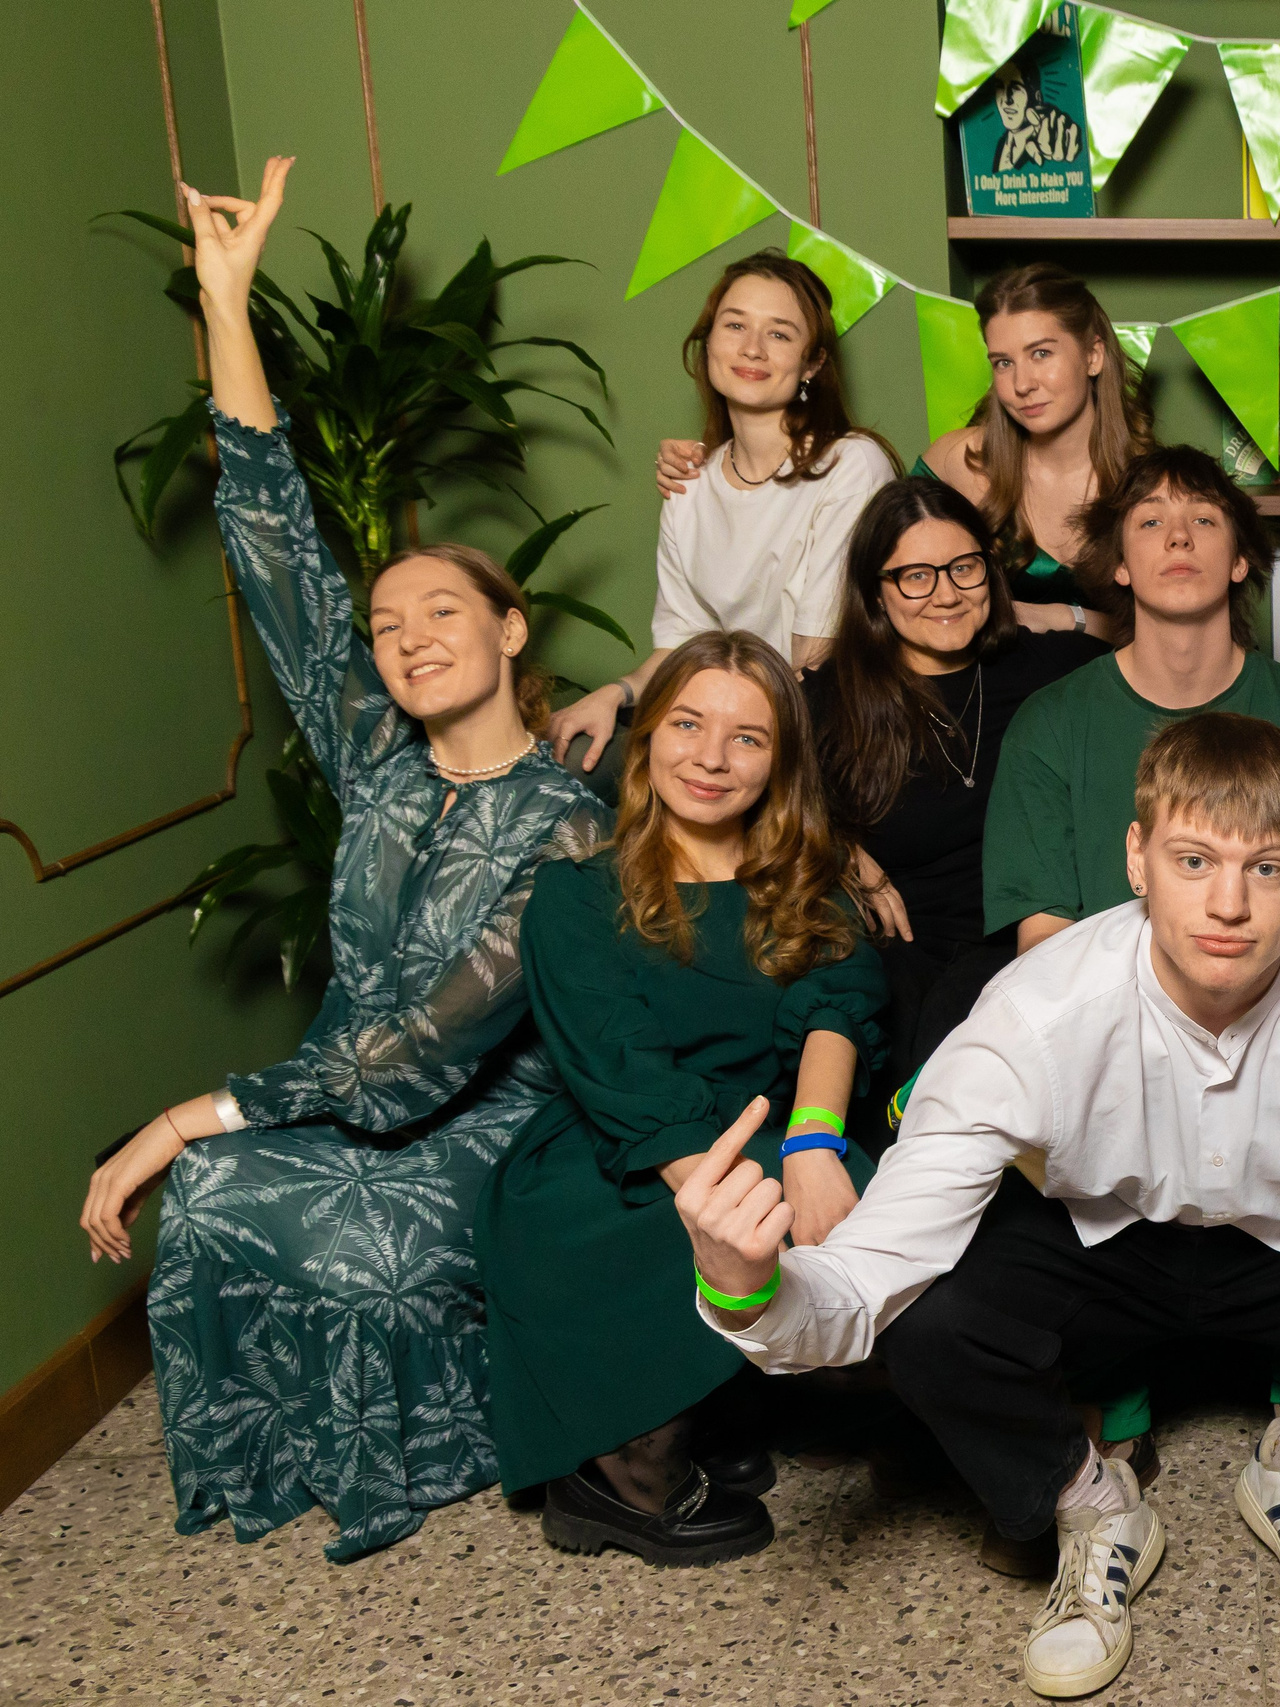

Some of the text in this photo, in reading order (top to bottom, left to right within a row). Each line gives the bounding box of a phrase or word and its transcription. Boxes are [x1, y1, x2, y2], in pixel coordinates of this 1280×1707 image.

[974, 171, 1083, 191] I Only Drink To Make YOU
[1018, 188, 1069, 205] Interesting!
